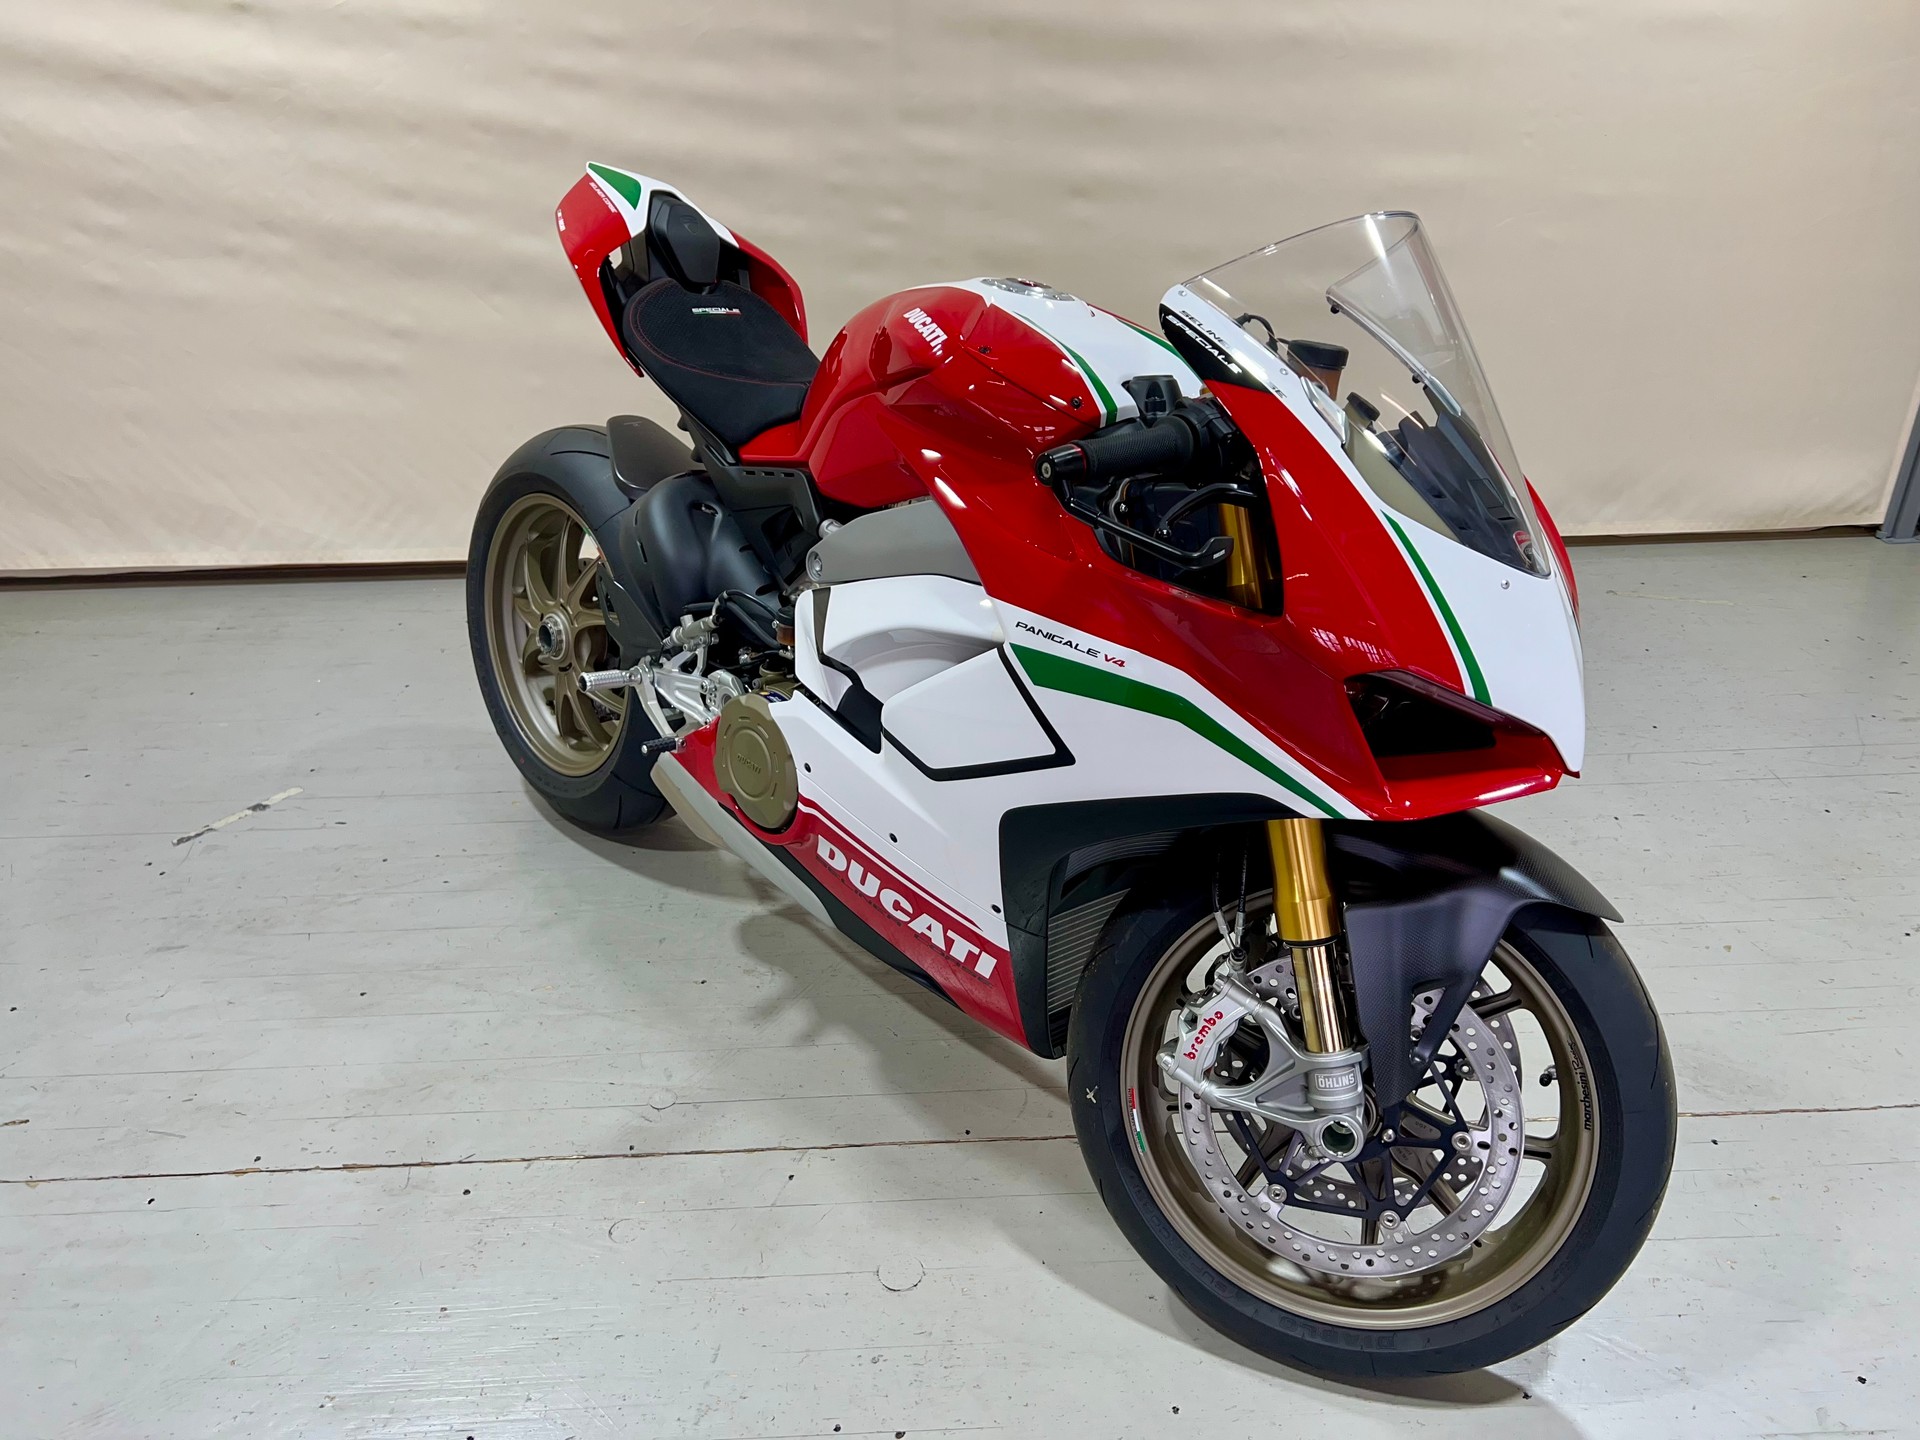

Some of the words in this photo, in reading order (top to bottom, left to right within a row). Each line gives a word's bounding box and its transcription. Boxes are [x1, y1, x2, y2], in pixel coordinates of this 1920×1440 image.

[903, 307, 948, 347] DUCATI
[1165, 314, 1243, 374] SPECIALE
[1180, 310, 1231, 349] SELINE
[1015, 621, 1101, 658] PANIGALE
[1103, 653, 1126, 668] V4
[816, 834, 998, 980] DUCATI
[1183, 1010, 1224, 1060] brembo
[1317, 1073, 1355, 1088] ÖHLINS
[1575, 1072, 1592, 1131] marchesini
